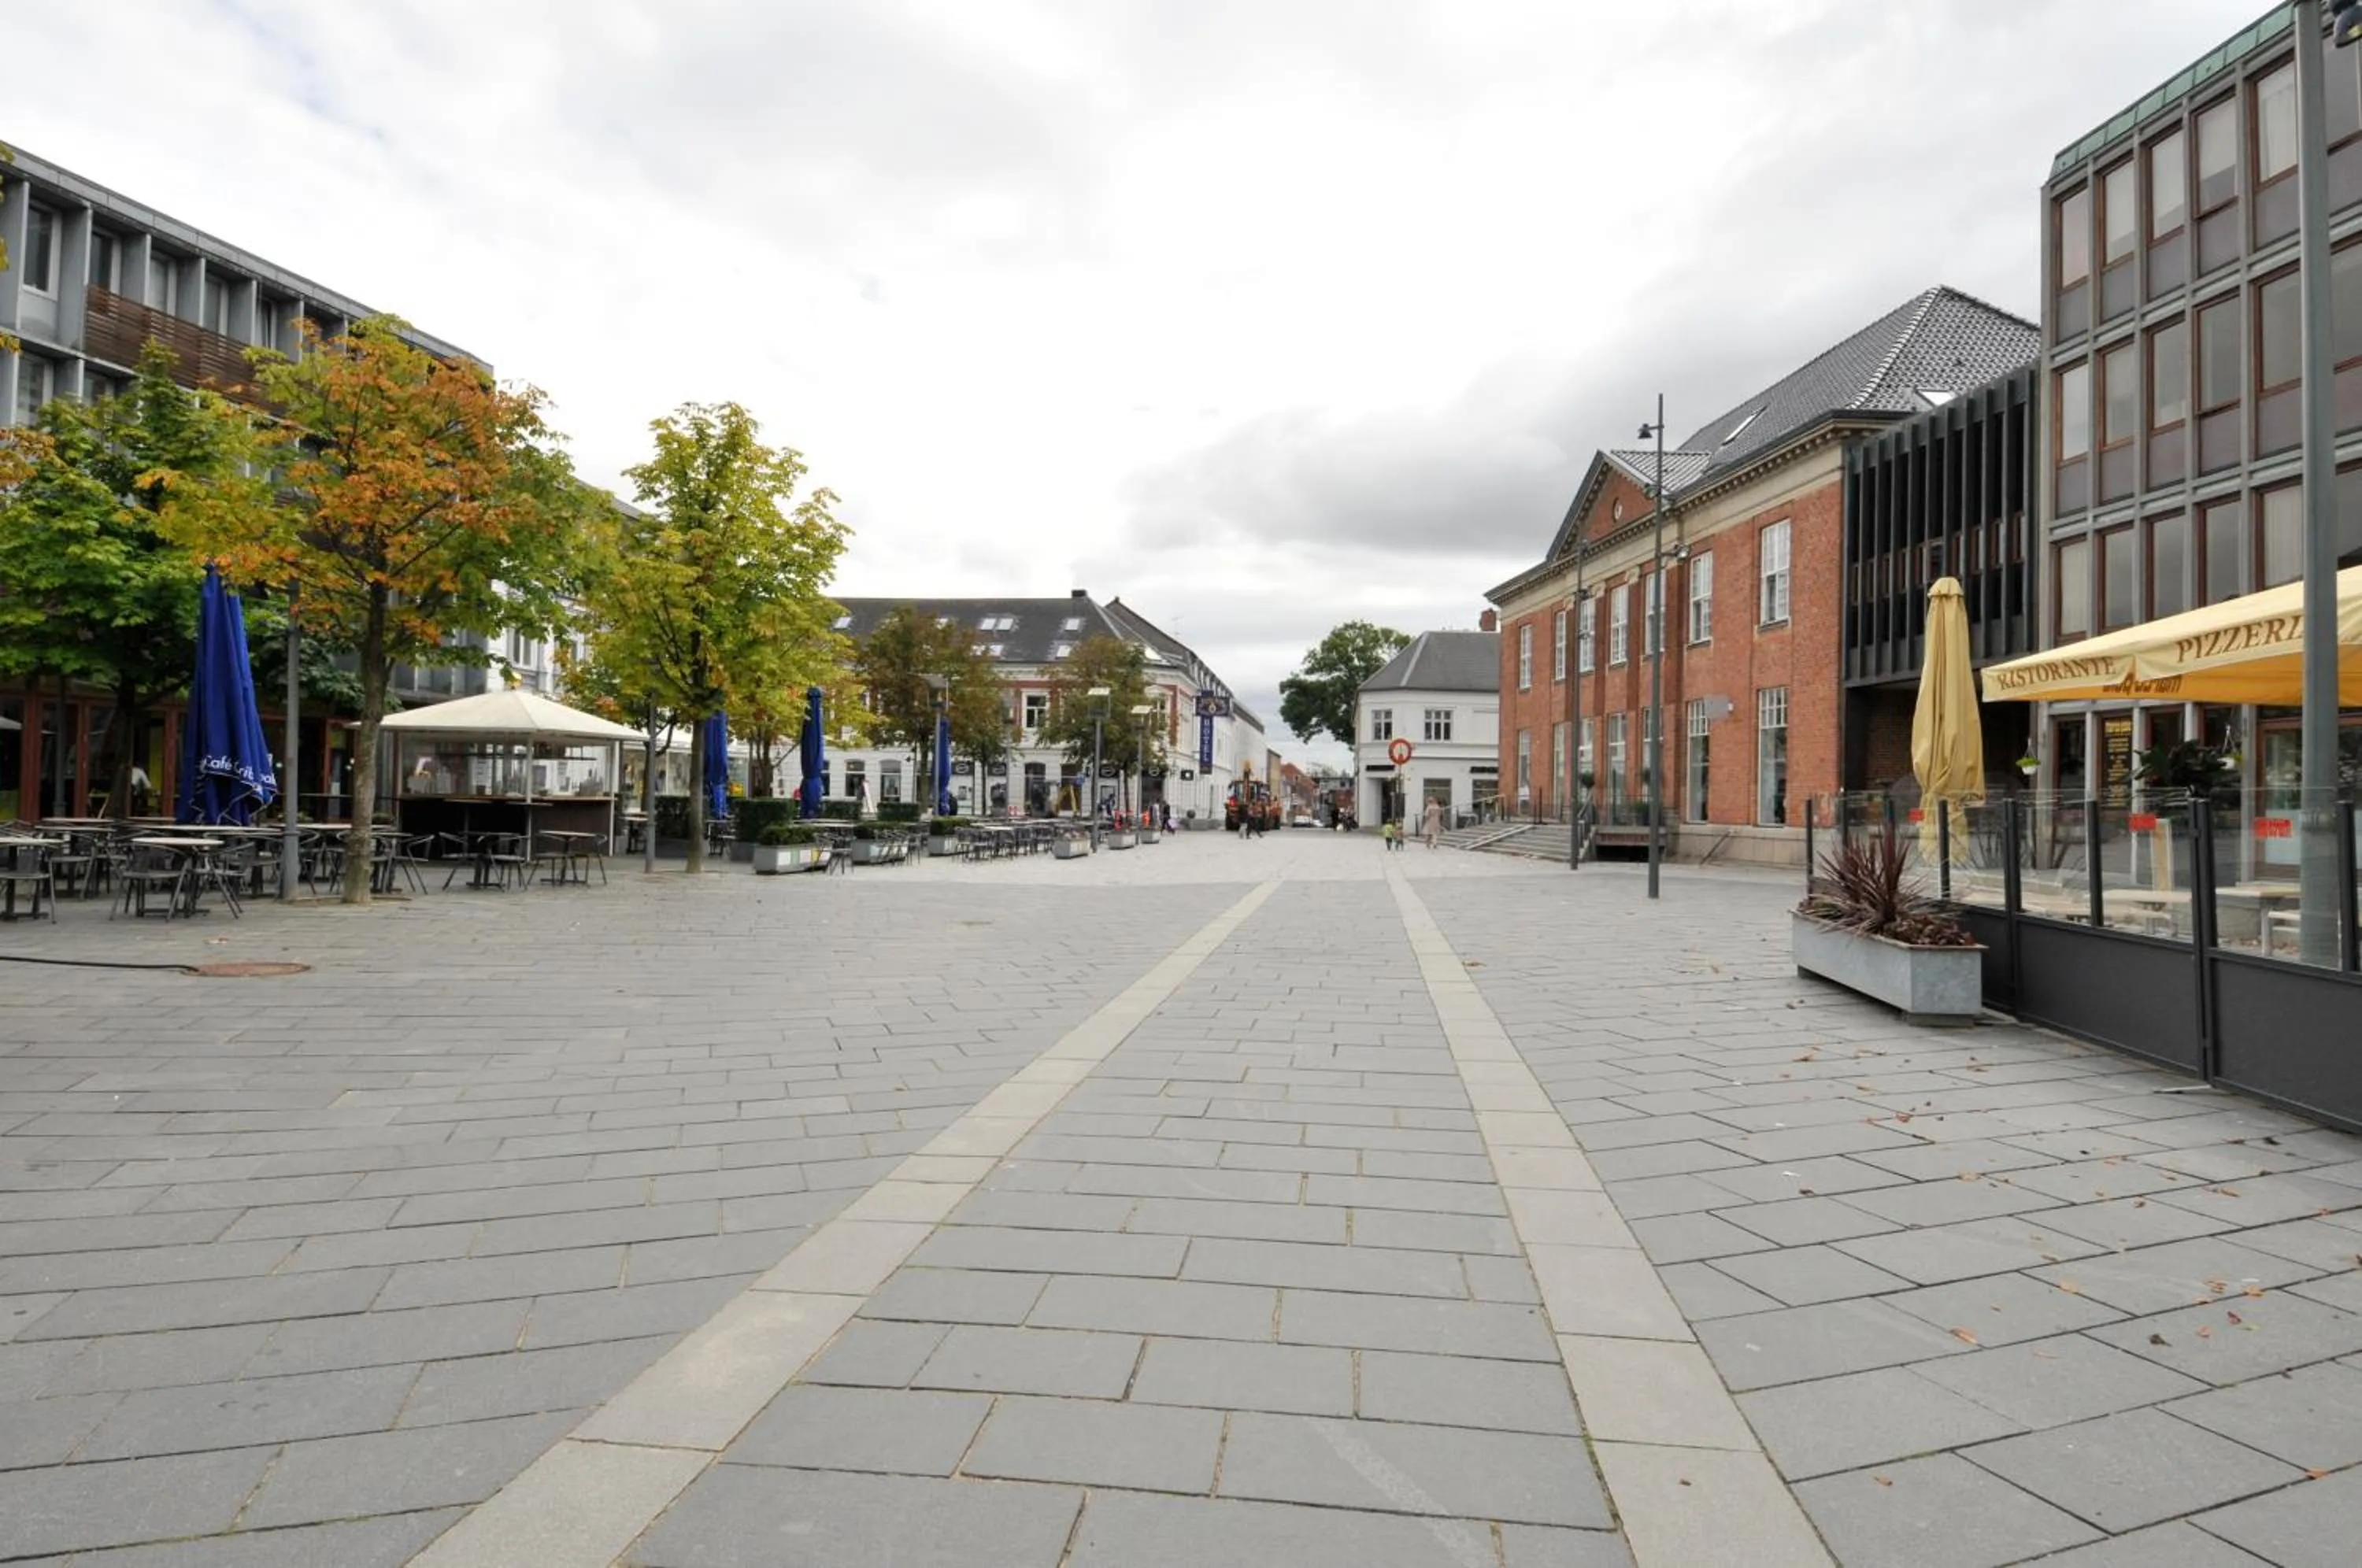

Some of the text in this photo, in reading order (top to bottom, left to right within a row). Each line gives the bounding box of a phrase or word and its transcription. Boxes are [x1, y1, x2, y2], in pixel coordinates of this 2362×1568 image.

[2175, 614, 2305, 663] PIZZERI
[1997, 656, 2116, 690] RISTORANTE
[1201, 718, 1211, 763] HOTEL
